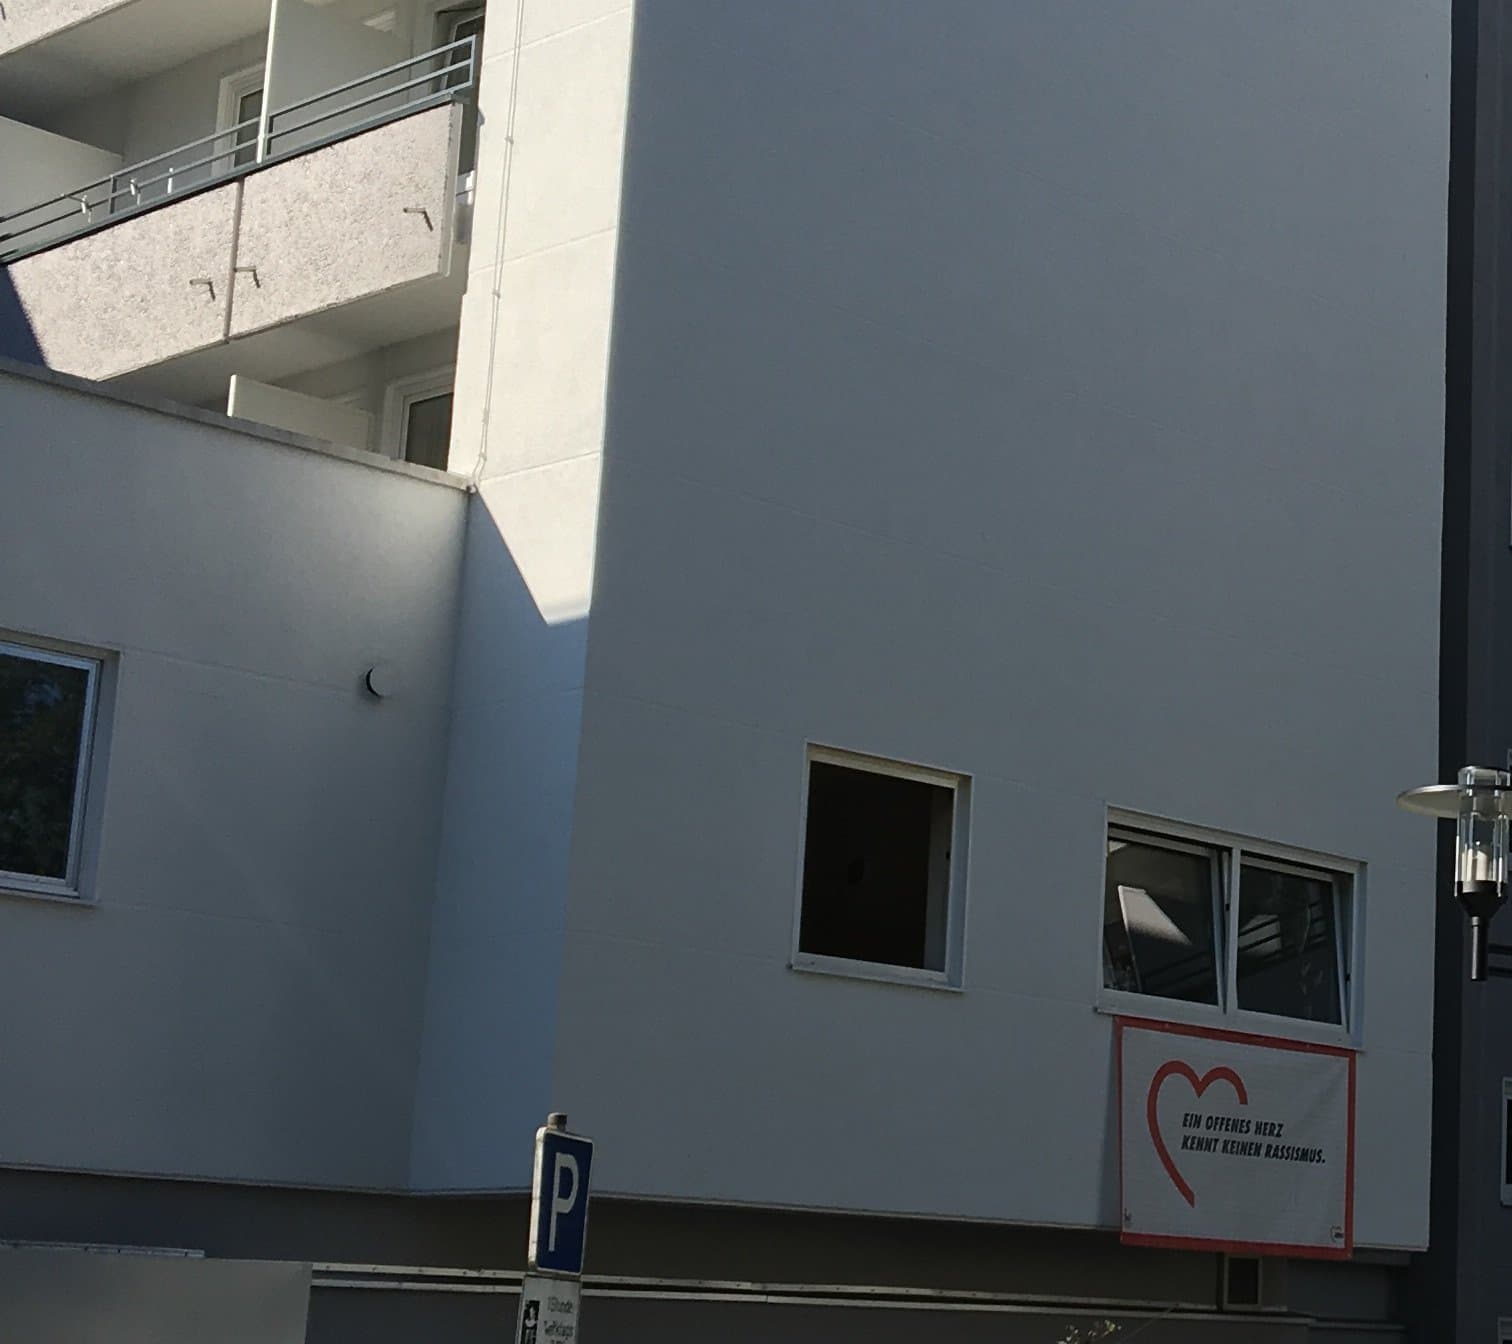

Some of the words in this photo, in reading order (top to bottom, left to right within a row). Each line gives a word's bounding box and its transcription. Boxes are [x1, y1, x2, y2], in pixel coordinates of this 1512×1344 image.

[1182, 1113, 1202, 1130] EIN
[1205, 1115, 1251, 1135] OFFENES
[1254, 1120, 1285, 1138] HERZ
[1181, 1135, 1220, 1153] KENNT
[1221, 1138, 1262, 1158] KEINEN
[1264, 1142, 1327, 1164] RASSISMUS.
[548, 1151, 580, 1252] P
